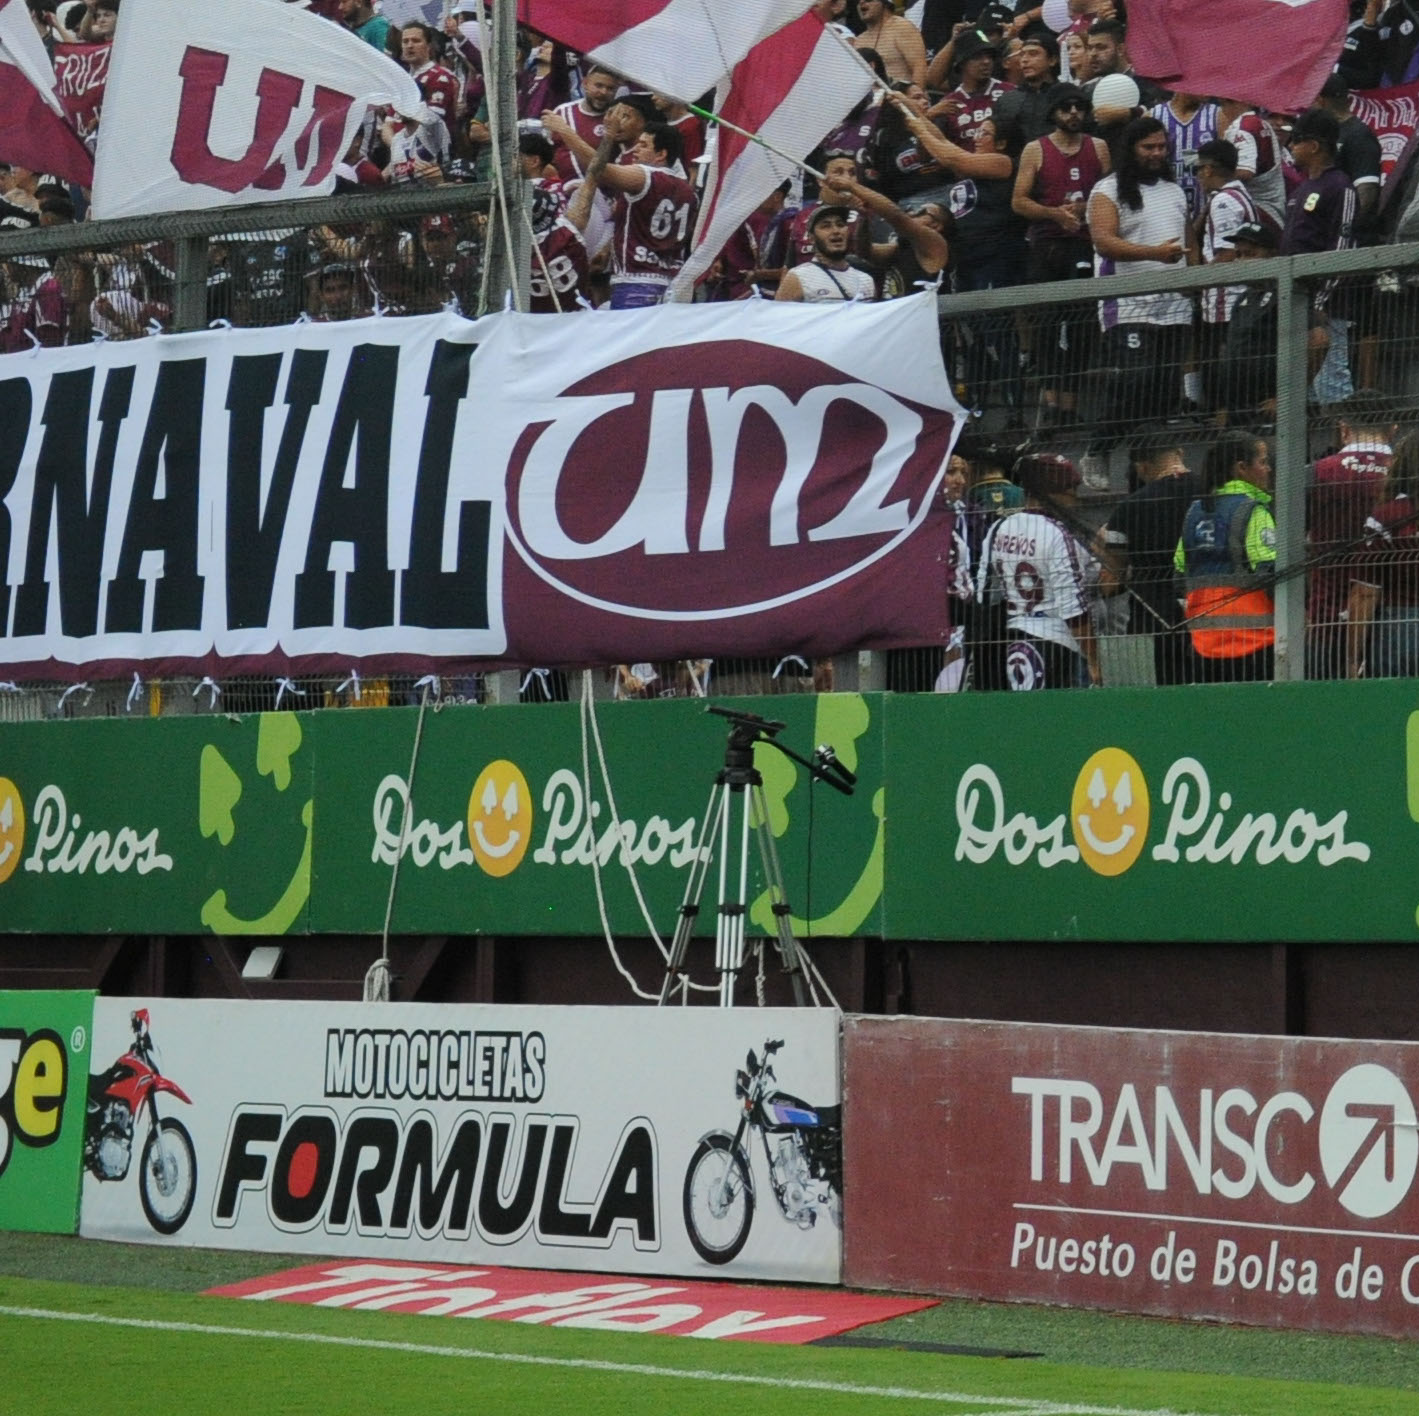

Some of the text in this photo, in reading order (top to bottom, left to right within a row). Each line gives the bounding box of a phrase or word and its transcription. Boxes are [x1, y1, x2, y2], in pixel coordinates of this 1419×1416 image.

[648, 198, 690, 242] 61
[25, 784, 172, 873] Pinos
[373, 770, 712, 866] Dos Pinos
[955, 757, 1371, 868] Dos Pinos
[325, 1029, 546, 1103] MOTOCICLETAS
[217, 1111, 658, 1244] FORMULA
[1012, 1222, 1135, 1278] Puesto
[1151, 1230, 1198, 1284] de
[1213, 1239, 1318, 1296] Bolsa
[1336, 1246, 1383, 1300] de
